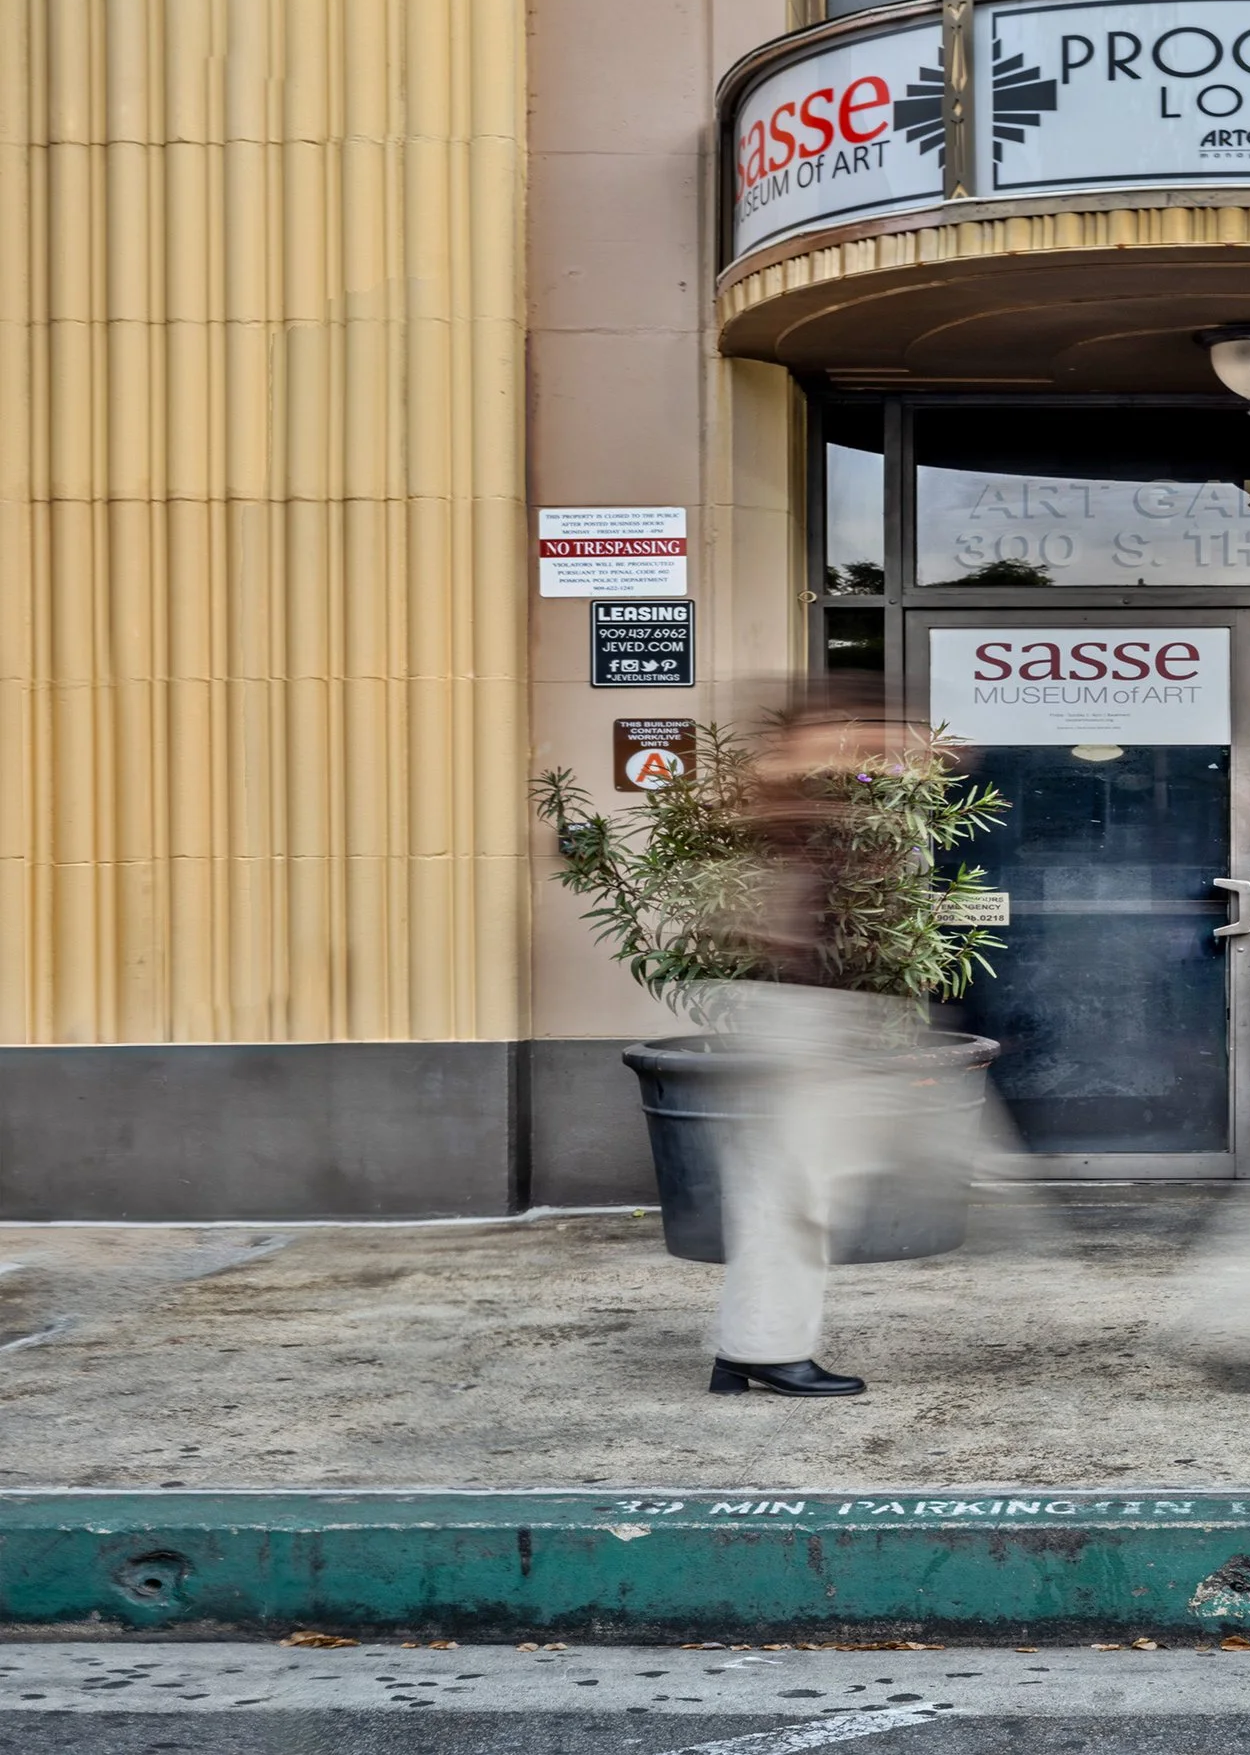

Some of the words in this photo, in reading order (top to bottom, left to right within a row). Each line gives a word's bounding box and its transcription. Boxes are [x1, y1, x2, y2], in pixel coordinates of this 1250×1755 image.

[832, 140, 891, 179] ART
[969, 480, 1113, 520] ART
[546, 542, 570, 555] NO
[573, 540, 681, 555] TRESPASSING
[953, 528, 1080, 569] 300
[1112, 528, 1169, 569] S.
[598, 607, 688, 621] LEASING
[599, 628, 687, 639] 909.437.6962
[602, 641, 684, 652] JEVED.COM
[974, 642, 1200, 681] sasse
[974, 686, 1108, 704] MUSEUM
[1113, 686, 1140, 704] of
[1141, 686, 1203, 704] ART
[635, 753, 674, 784] A
[709, 1500, 816, 1515] MIN.
[838, 1500, 1077, 1515] PARKING
